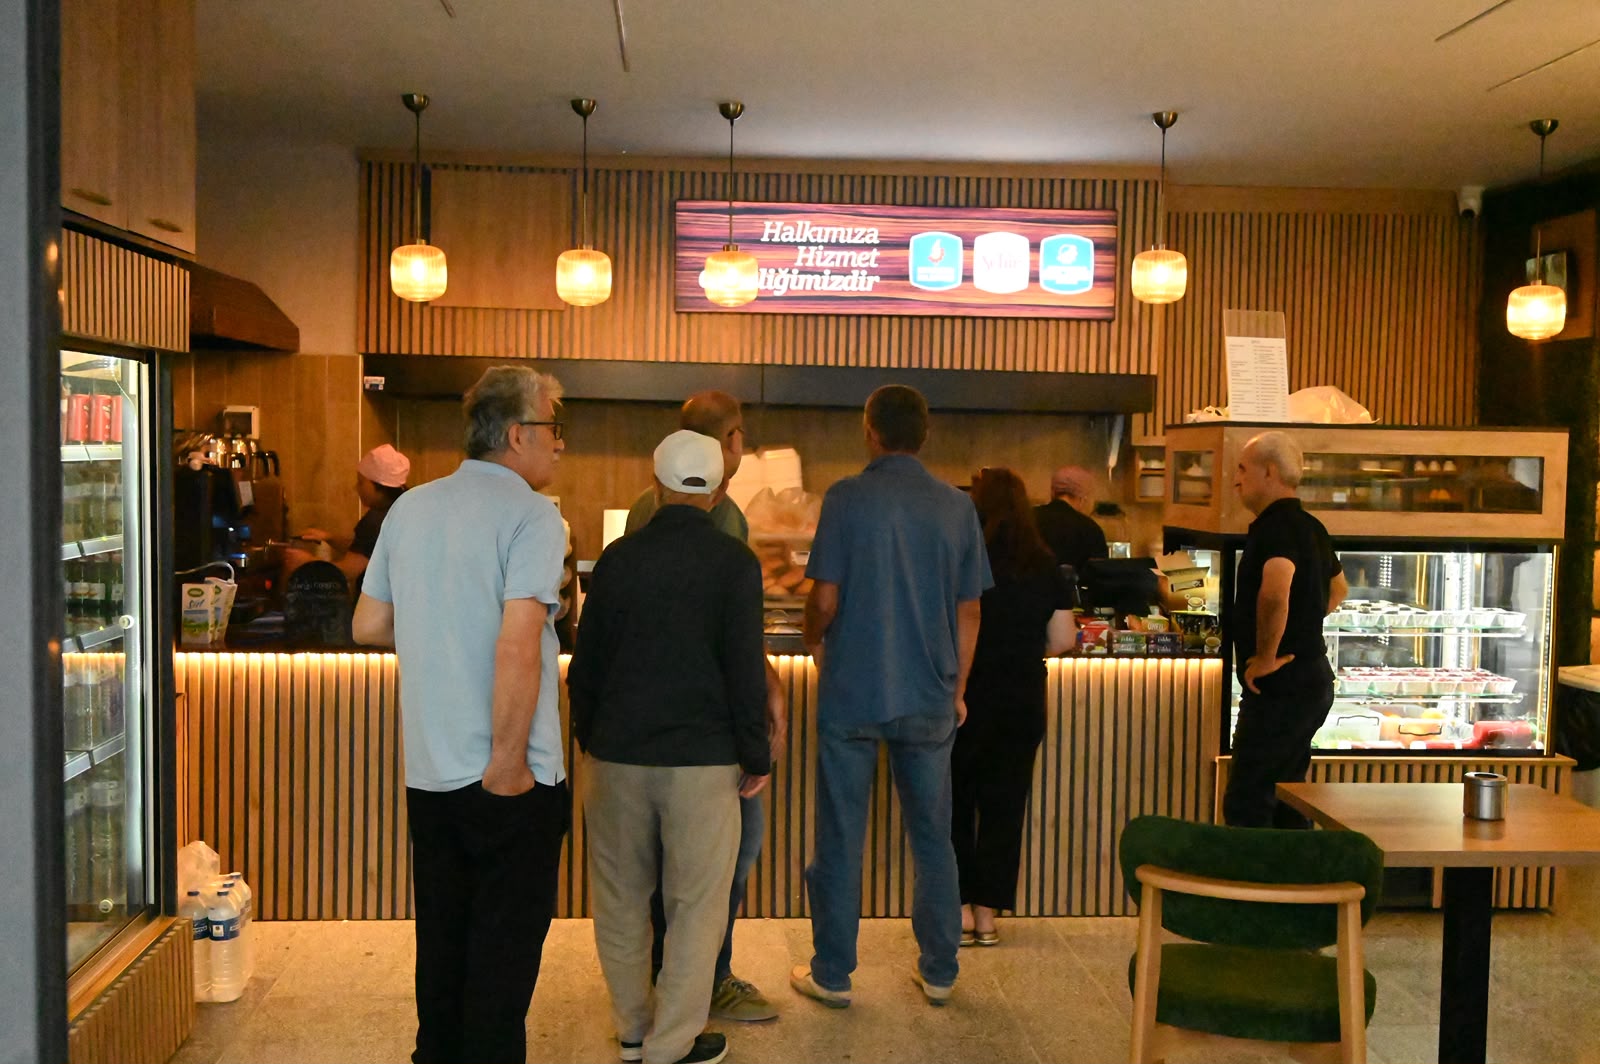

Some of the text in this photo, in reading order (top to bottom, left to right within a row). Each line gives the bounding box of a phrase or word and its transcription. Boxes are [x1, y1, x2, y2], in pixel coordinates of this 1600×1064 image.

[760, 220, 880, 244] Halkımıza
[794, 245, 880, 268] Hizmet
[699, 268, 880, 296] liğimizdir
